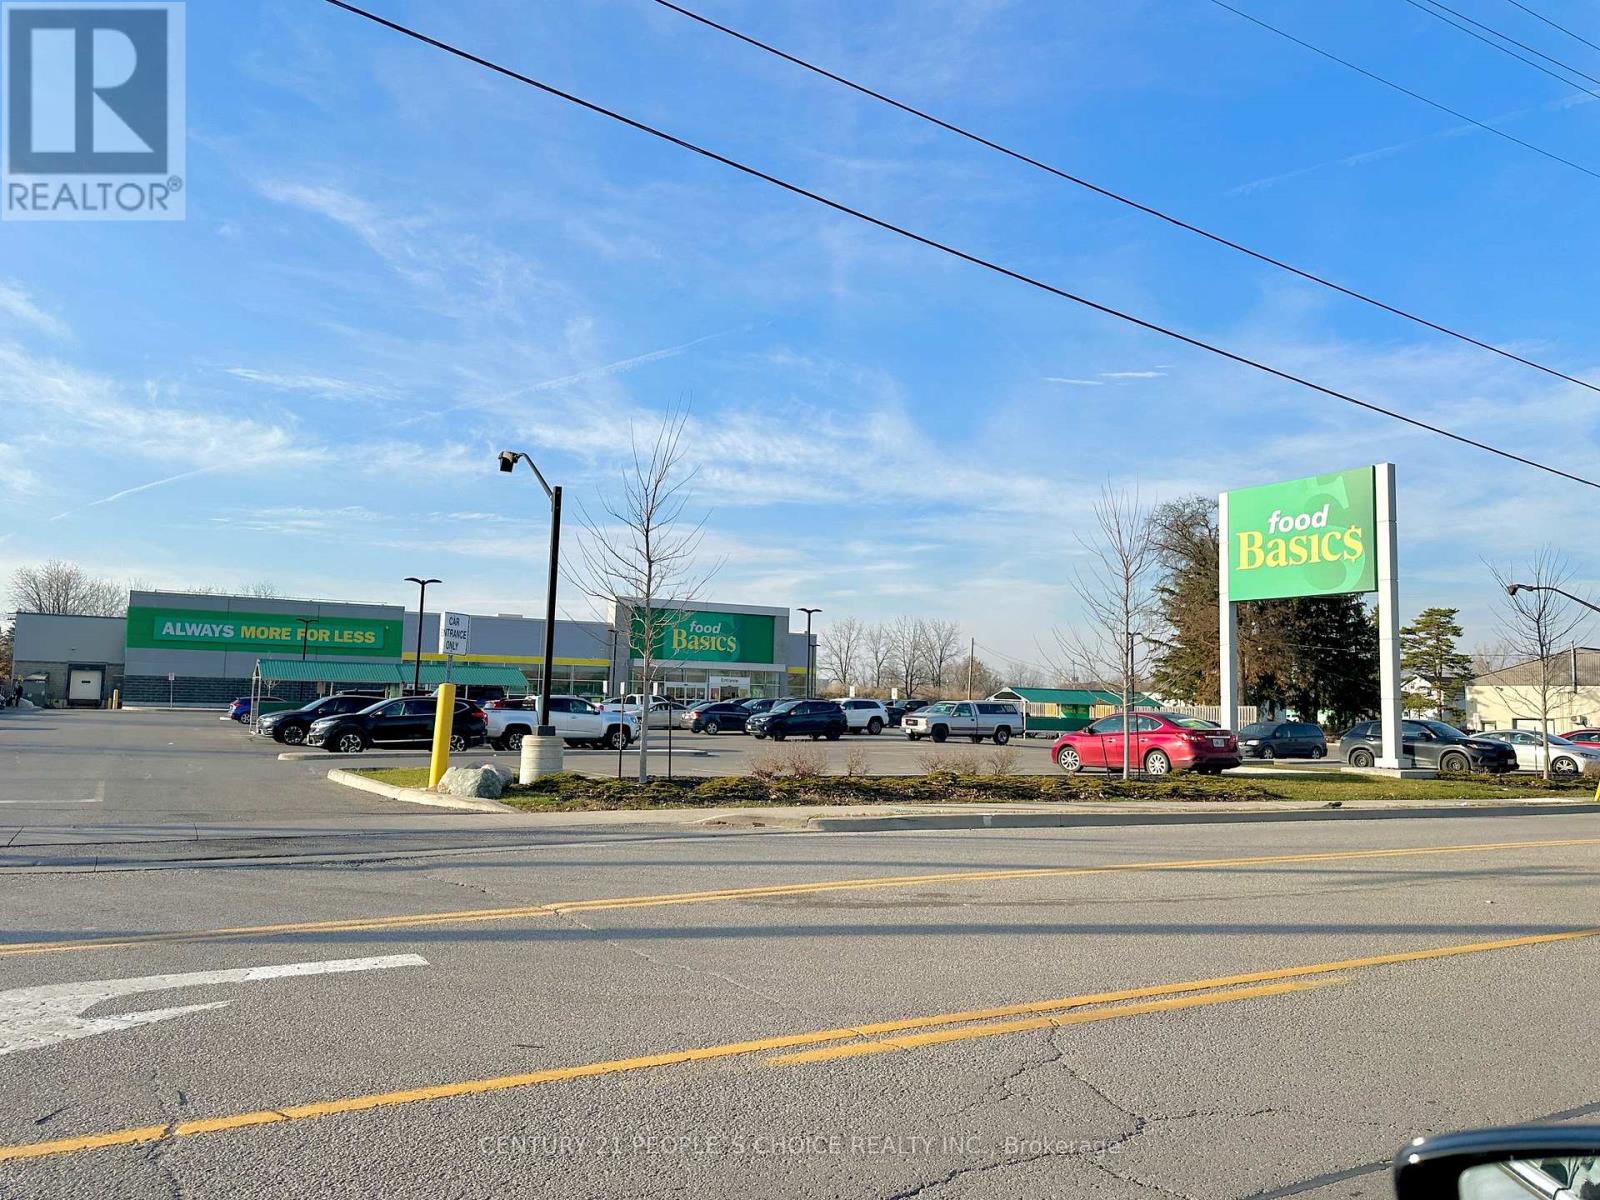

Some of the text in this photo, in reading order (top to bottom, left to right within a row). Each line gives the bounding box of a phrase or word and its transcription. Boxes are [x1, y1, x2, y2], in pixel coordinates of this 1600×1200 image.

[1268, 503, 1330, 534] food
[448, 616, 460, 626] CAR
[689, 621, 721, 634] food
[162, 622, 376, 643] ALWAYS MORE FOR LESS
[445, 640, 459, 651] ONLY
